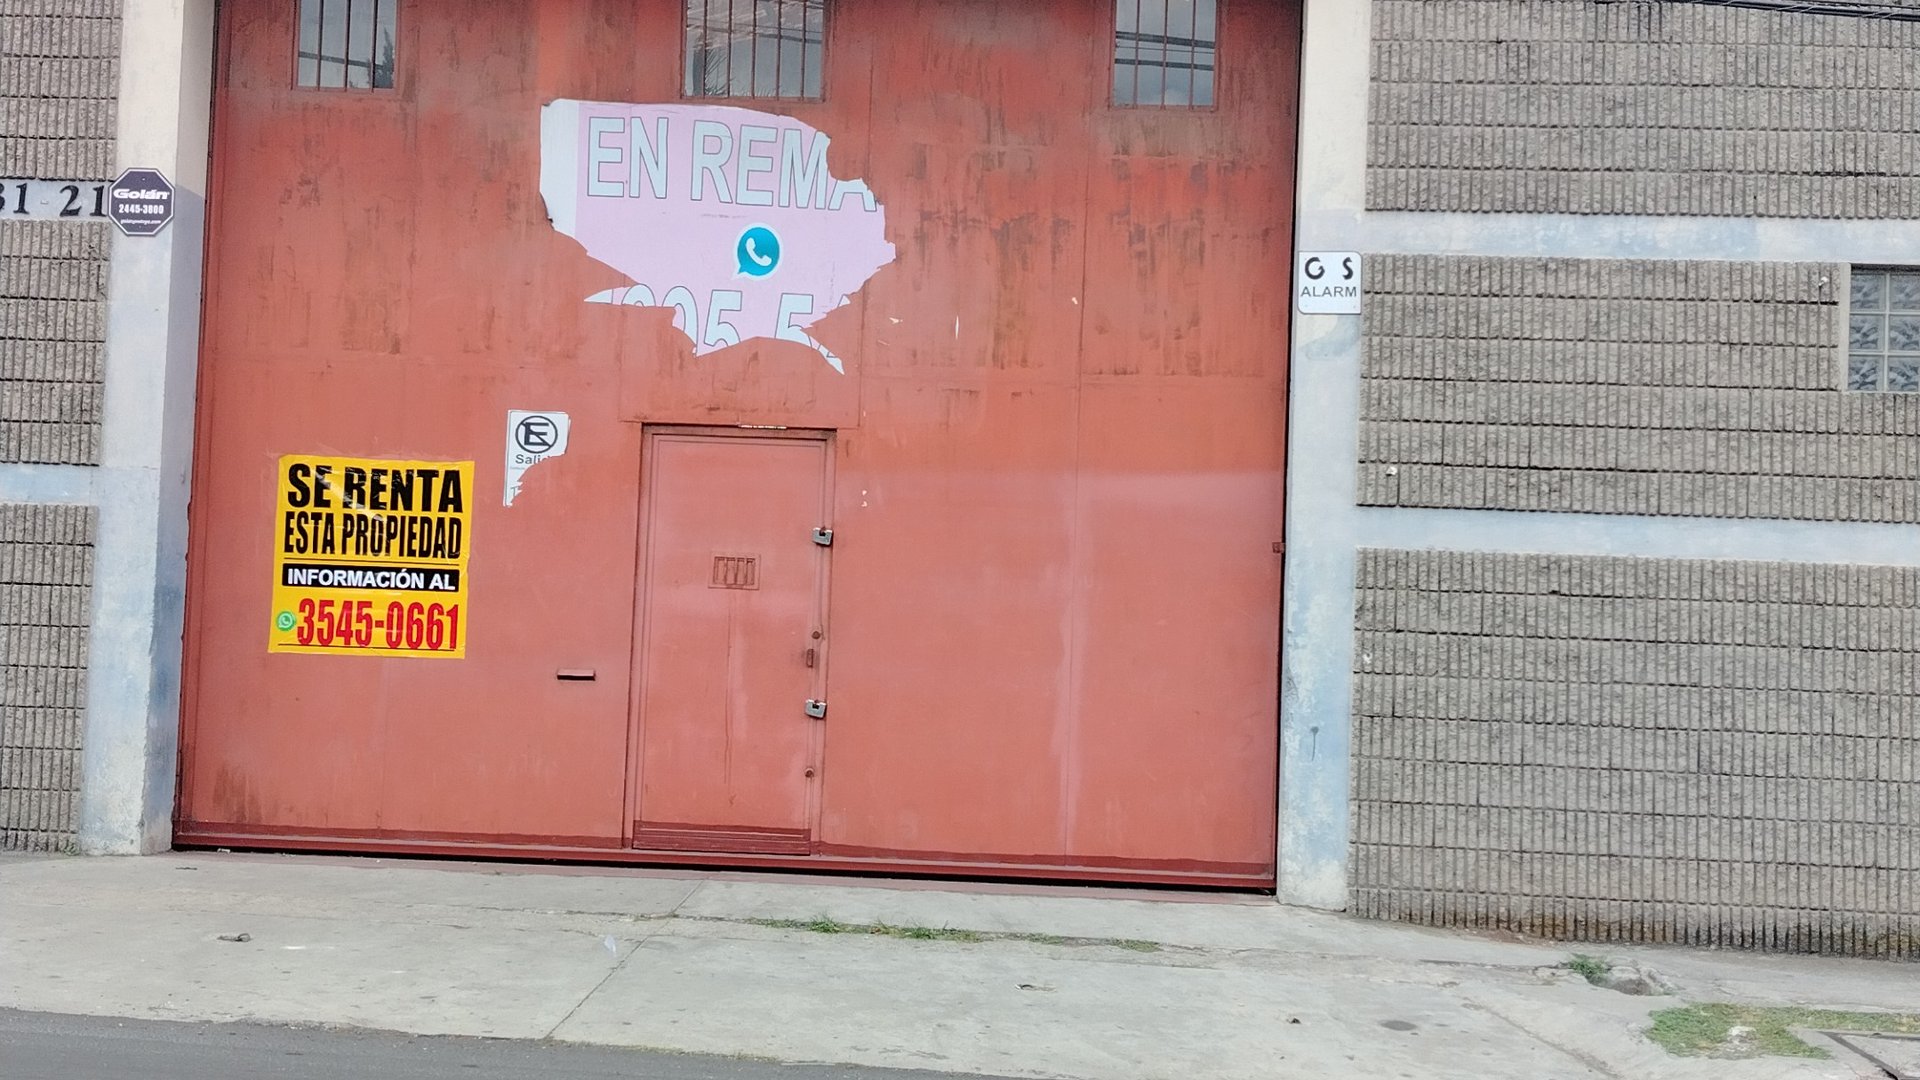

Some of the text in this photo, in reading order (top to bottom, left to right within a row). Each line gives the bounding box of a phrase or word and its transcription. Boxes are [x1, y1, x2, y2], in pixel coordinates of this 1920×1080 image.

[587, 116, 669, 199] EN
[0, 182, 107, 217] 1 21
[118, 203, 165, 214] 2445-3800
[1300, 286, 1357, 297] ALARM
[515, 454, 550, 465] Sali
[287, 463, 332, 508] SE
[342, 466, 463, 513] RENTA
[284, 510, 462, 560] ESTA PROPIEDAD
[287, 568, 456, 590] INFORMACIÓN AL
[297, 598, 459, 650] 3545-0661
